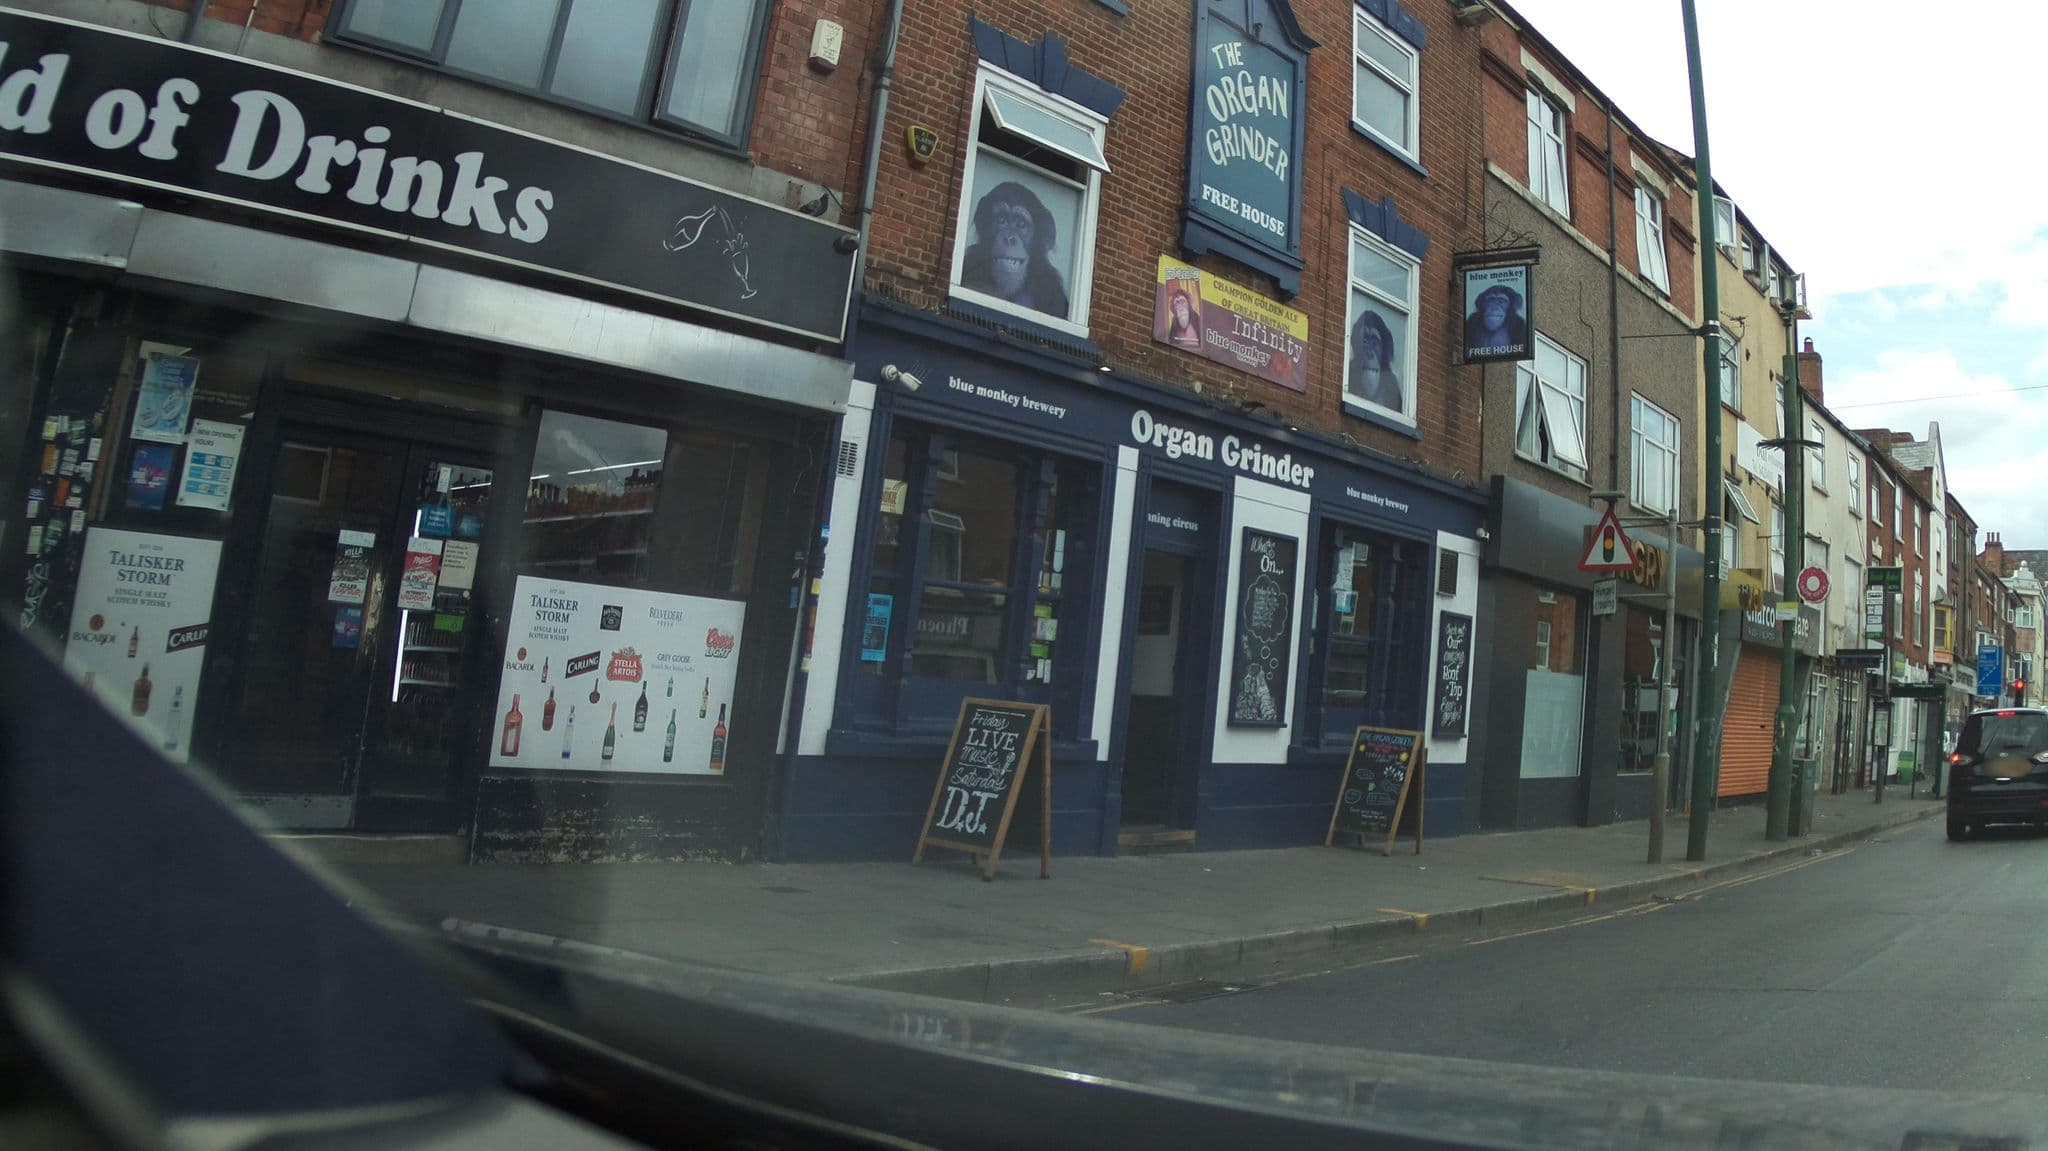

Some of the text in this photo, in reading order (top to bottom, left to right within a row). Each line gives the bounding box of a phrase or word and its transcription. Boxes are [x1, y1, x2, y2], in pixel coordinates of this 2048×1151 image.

[1212, 42, 1244, 70] THE
[1206, 70, 1289, 123] ORGAN
[0, 42, 554, 243] d of Drinks
[1206, 124, 1289, 182] GRINDER
[1202, 183, 1286, 237] FREE HOUSE
[1469, 269, 1524, 281] blue monkey
[1213, 280, 1298, 323] CHAMPION GOLDEN ALE
[1222, 298, 1233, 311] OF
[1234, 302, 1258, 320] GREAT
[1206, 328, 1271, 366] blue monkey
[1231, 314, 1303, 364] Infinity
[1469, 344, 1524, 357] FREE HOUSE
[949, 376, 1066, 419] blue monkey brewery
[1131, 409, 1315, 488] Organ Grinder
[1346, 486, 1409, 514] blue monkey brewery
[1172, 517, 1198, 532] circus
[109, 550, 185, 572] TALISKER
[117, 568, 171, 586] STORM
[530, 594, 579, 612] TALISKER
[535, 610, 570, 624] STORM
[72, 631, 118, 645] BACARDI
[505, 661, 535, 672] BACARDI
[568, 655, 599, 674] CARLING
[613, 667, 638, 677] ARTOIS
[614, 658, 638, 669] STELLA
[971, 712, 1009, 730] Friday
[965, 728, 1019, 751] LIVE
[951, 767, 1007, 790] Saturday
